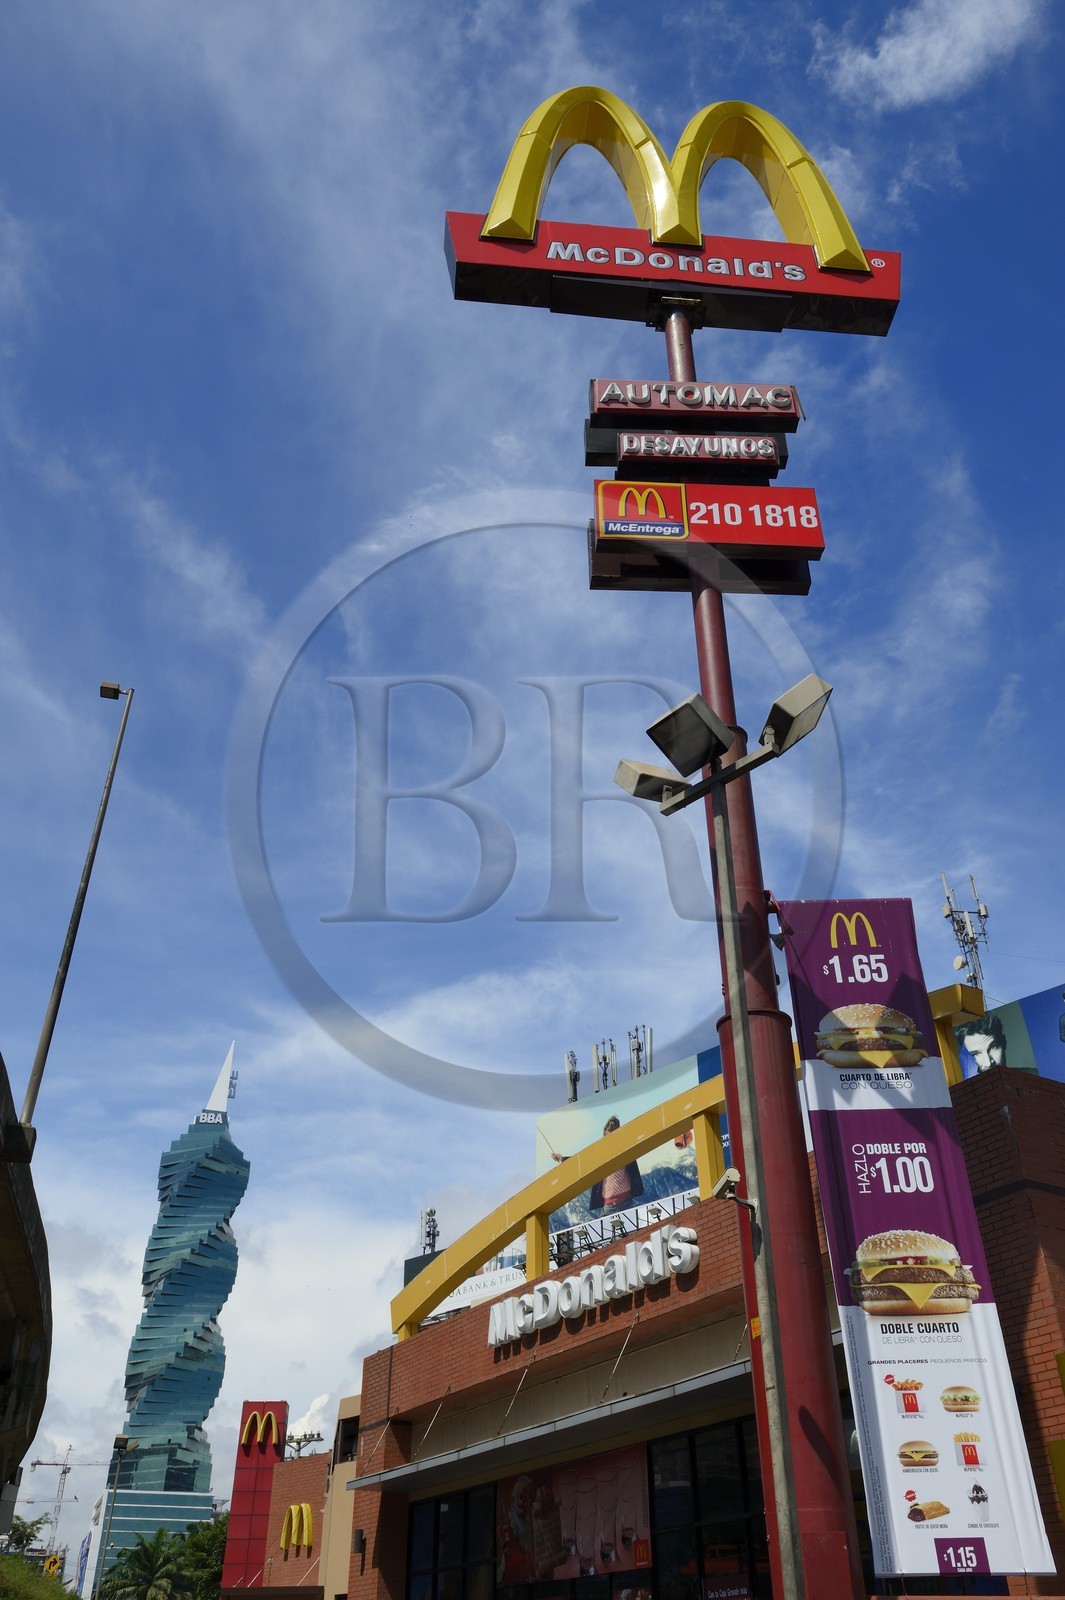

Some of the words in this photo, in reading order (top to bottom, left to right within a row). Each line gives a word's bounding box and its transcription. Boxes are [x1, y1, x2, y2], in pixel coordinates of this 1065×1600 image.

[546, 241, 807, 282] McDonald's
[599, 382, 793, 409] AUTOMAC
[622, 434, 775, 458] DESAYUNOS
[690, 502, 743, 526] 210
[748, 504, 819, 529] 1818
[608, 522, 680, 536] McEntrega
[823, 954, 889, 984] $1.65
[839, 1072, 872, 1082] CUARTO
[874, 1073, 885, 1081] DE
[841, 1081, 867, 1091] CON
[870, 1080, 913, 1090] QUESO
[866, 1143, 902, 1156] DOBLE
[903, 1142, 927, 1154] POR
[852, 1143, 872, 1194] HAZLO
[870, 1156, 935, 1194] $1.00
[487, 1224, 700, 1348] McDonald's
[499, 1270, 524, 1284] TRUS
[880, 1322, 915, 1335] DOBLE
[917, 1322, 960, 1334] CUARTO
[882, 1336, 893, 1345] DE
[919, 1335, 936, 1344] CON
[936, 1335, 963, 1344] QUESO
[943, 1546, 977, 1568] $1.15
